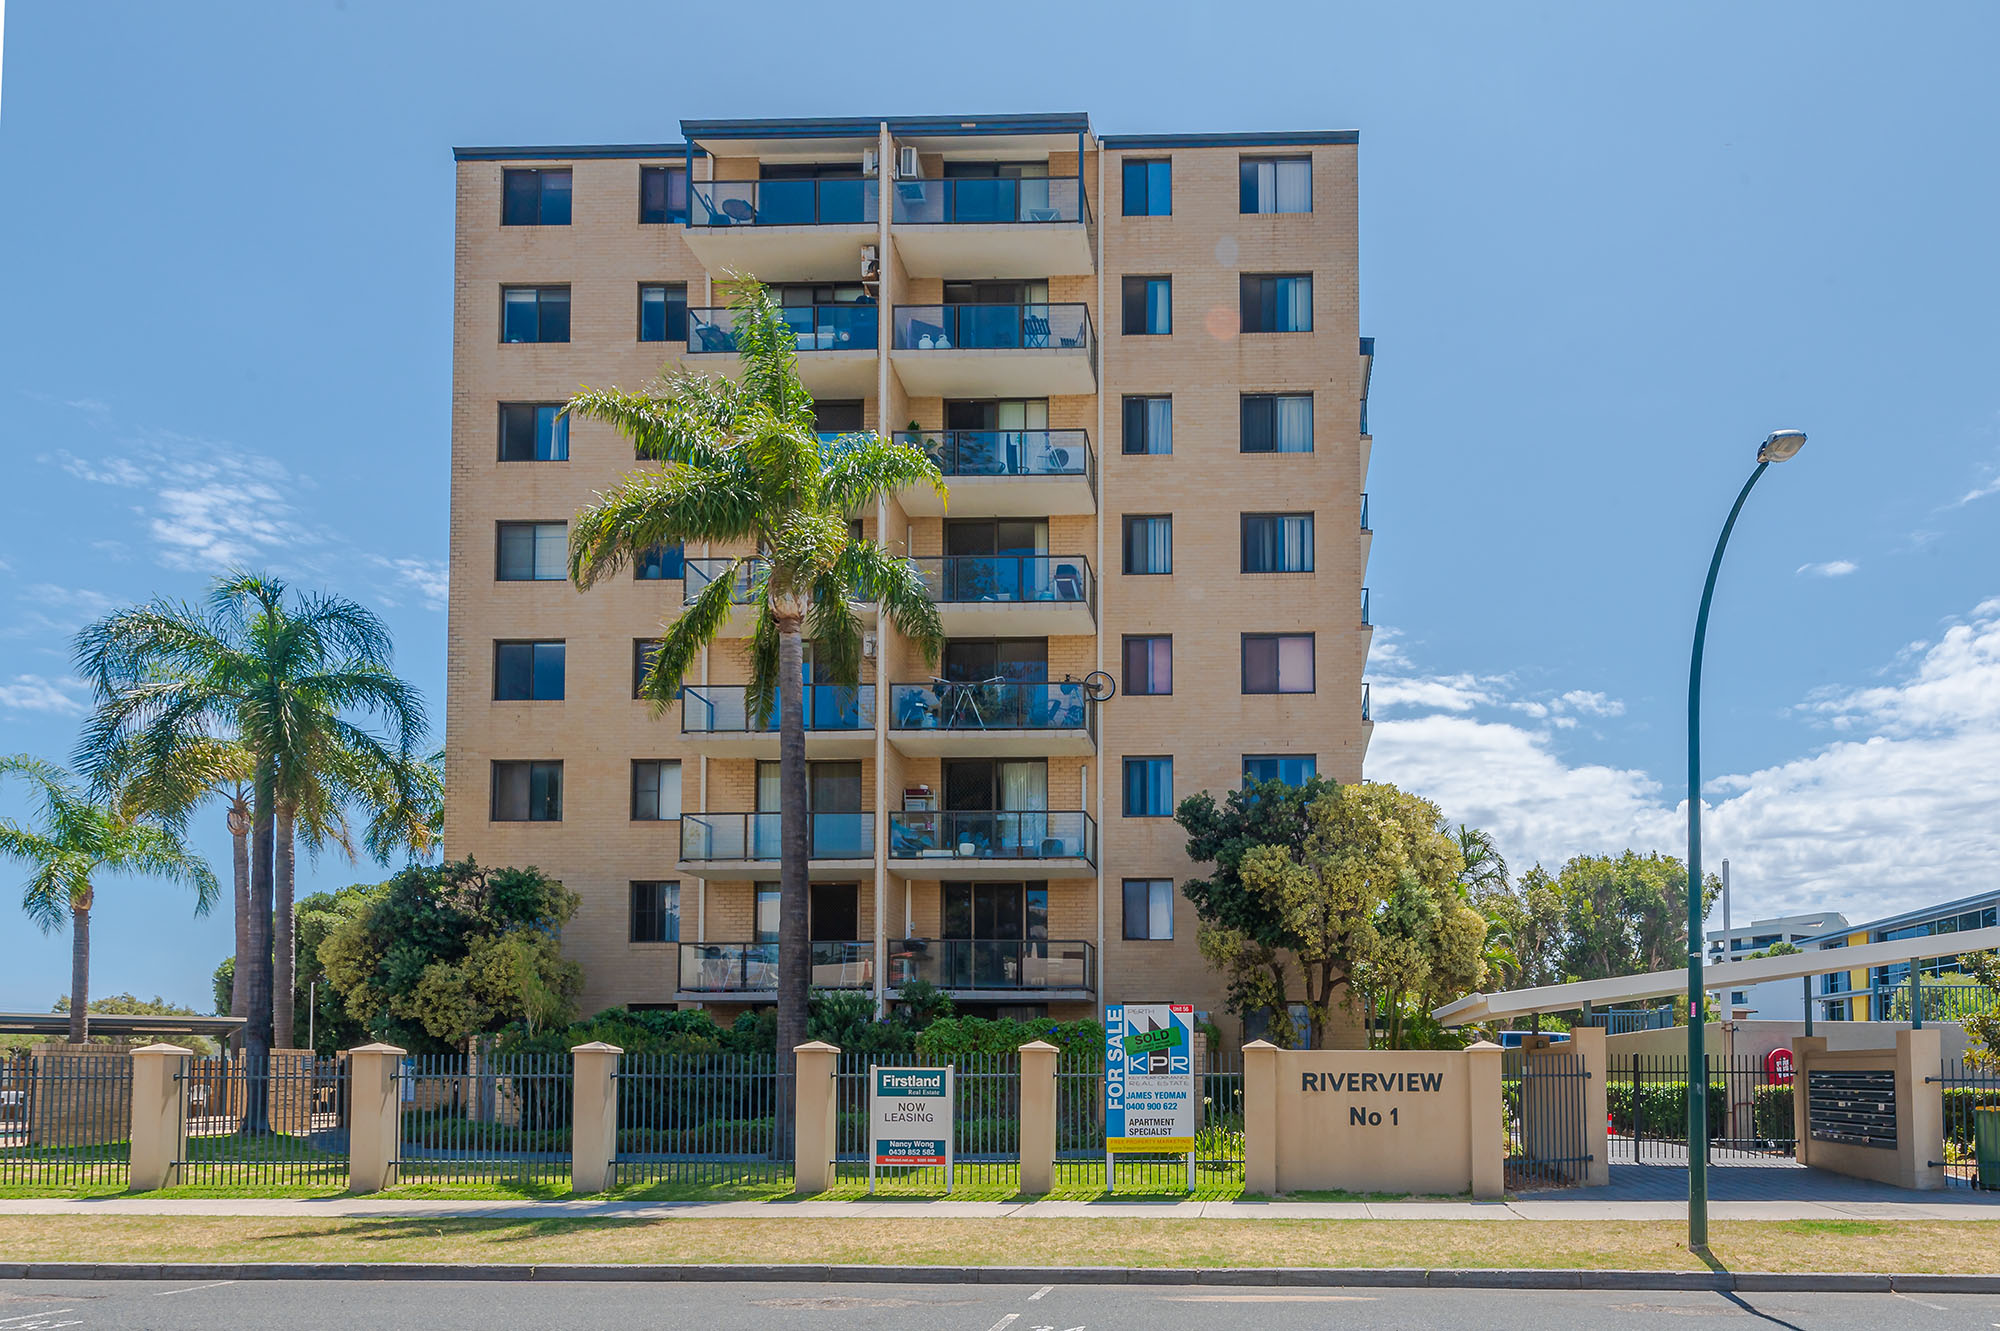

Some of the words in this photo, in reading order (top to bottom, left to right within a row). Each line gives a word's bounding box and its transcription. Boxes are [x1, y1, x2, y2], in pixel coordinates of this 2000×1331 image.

[1108, 1009, 1123, 1061] SALE
[1134, 1030, 1170, 1045] SOLD
[1130, 1056, 1188, 1072] KPR
[883, 1075, 940, 1087] Firstland
[1302, 1072, 1443, 1092] RIVERVIEW
[1108, 1068, 1123, 1110] FOR
[1154, 1091, 1187, 1099] YEOMAN
[898, 1102, 926, 1111] NOW
[1163, 1102, 1178, 1110] 622
[884, 1113, 934, 1122] LEASING
[1129, 1118, 1175, 1126] APARTMENT
[1350, 1107, 1382, 1126] No
[1390, 1108, 1398, 1126] 1
[1129, 1128, 1172, 1136] SPECIALIST
